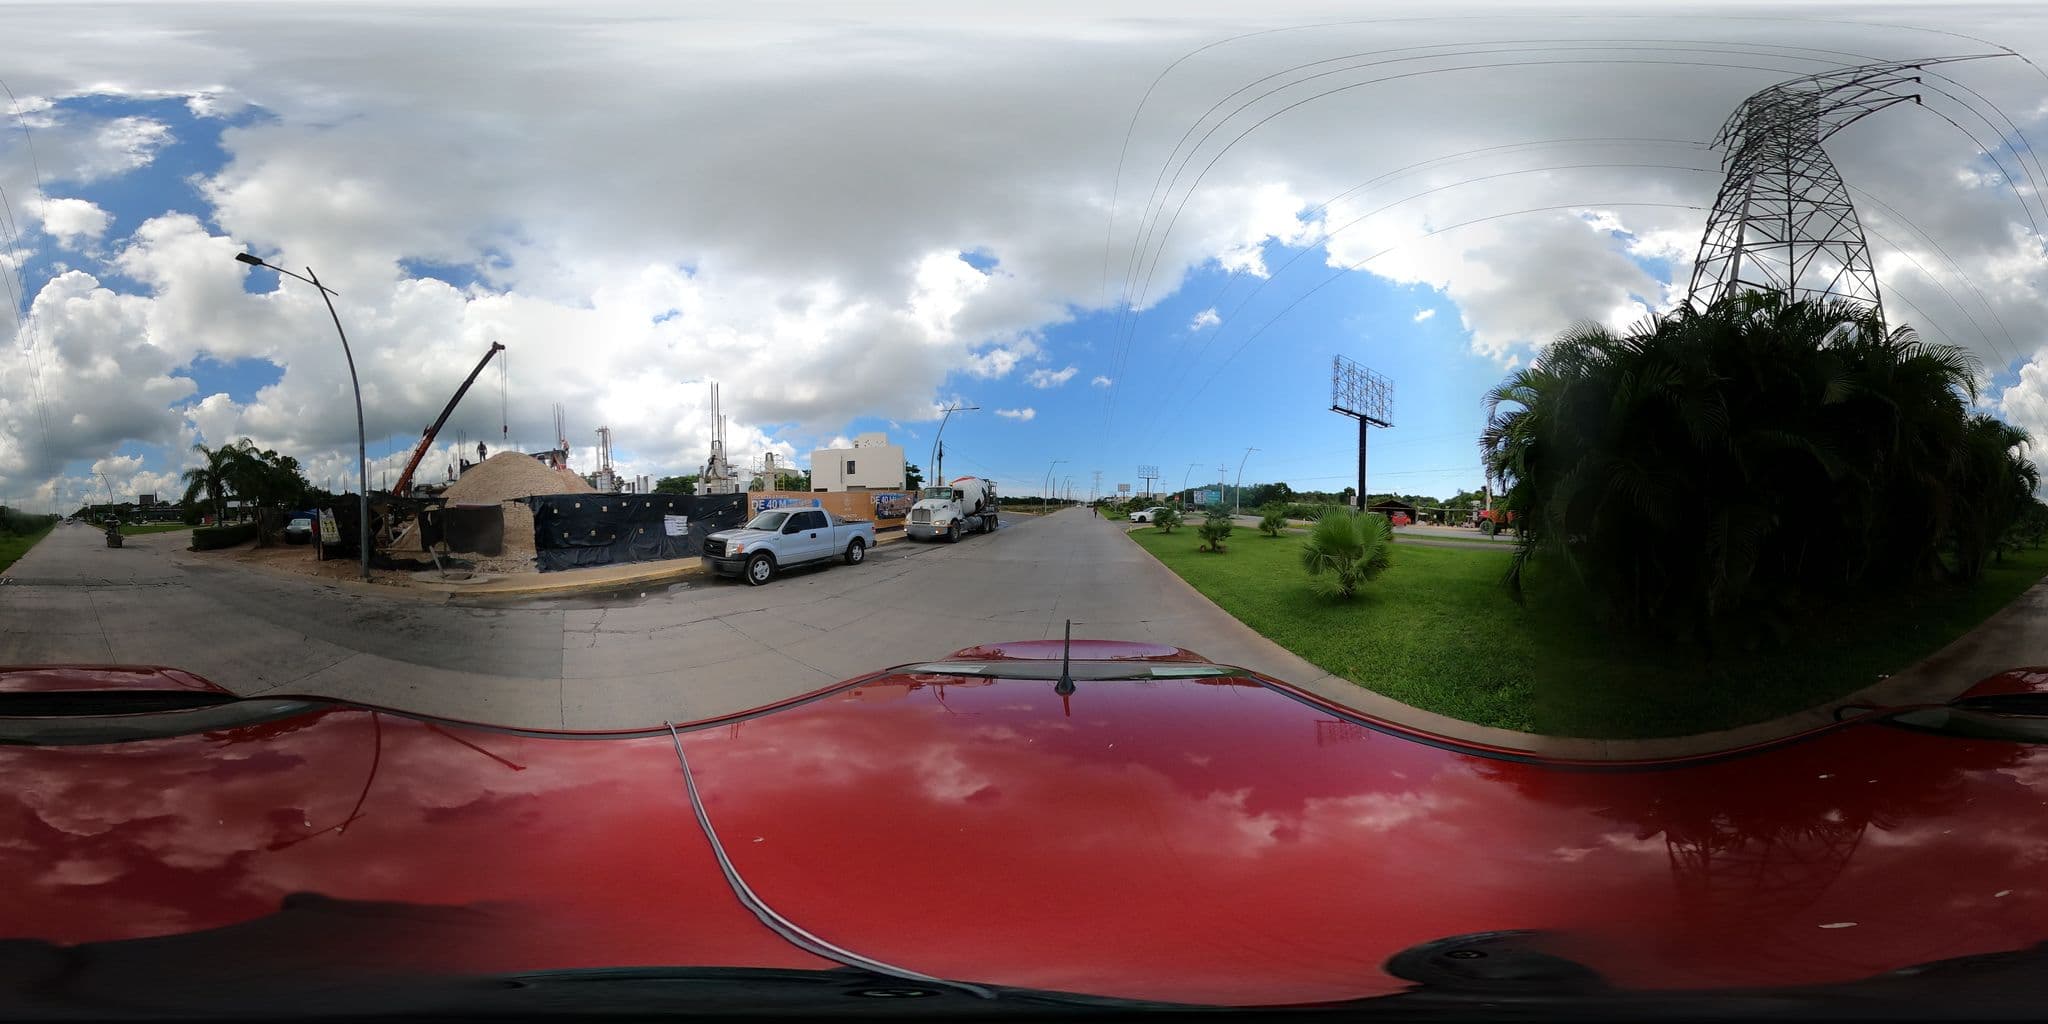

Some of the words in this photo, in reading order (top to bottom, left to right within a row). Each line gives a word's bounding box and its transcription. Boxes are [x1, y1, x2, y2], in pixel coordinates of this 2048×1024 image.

[871, 496, 880, 504] DE
[752, 500, 765, 510] DE
[766, 500, 777, 509] 40
